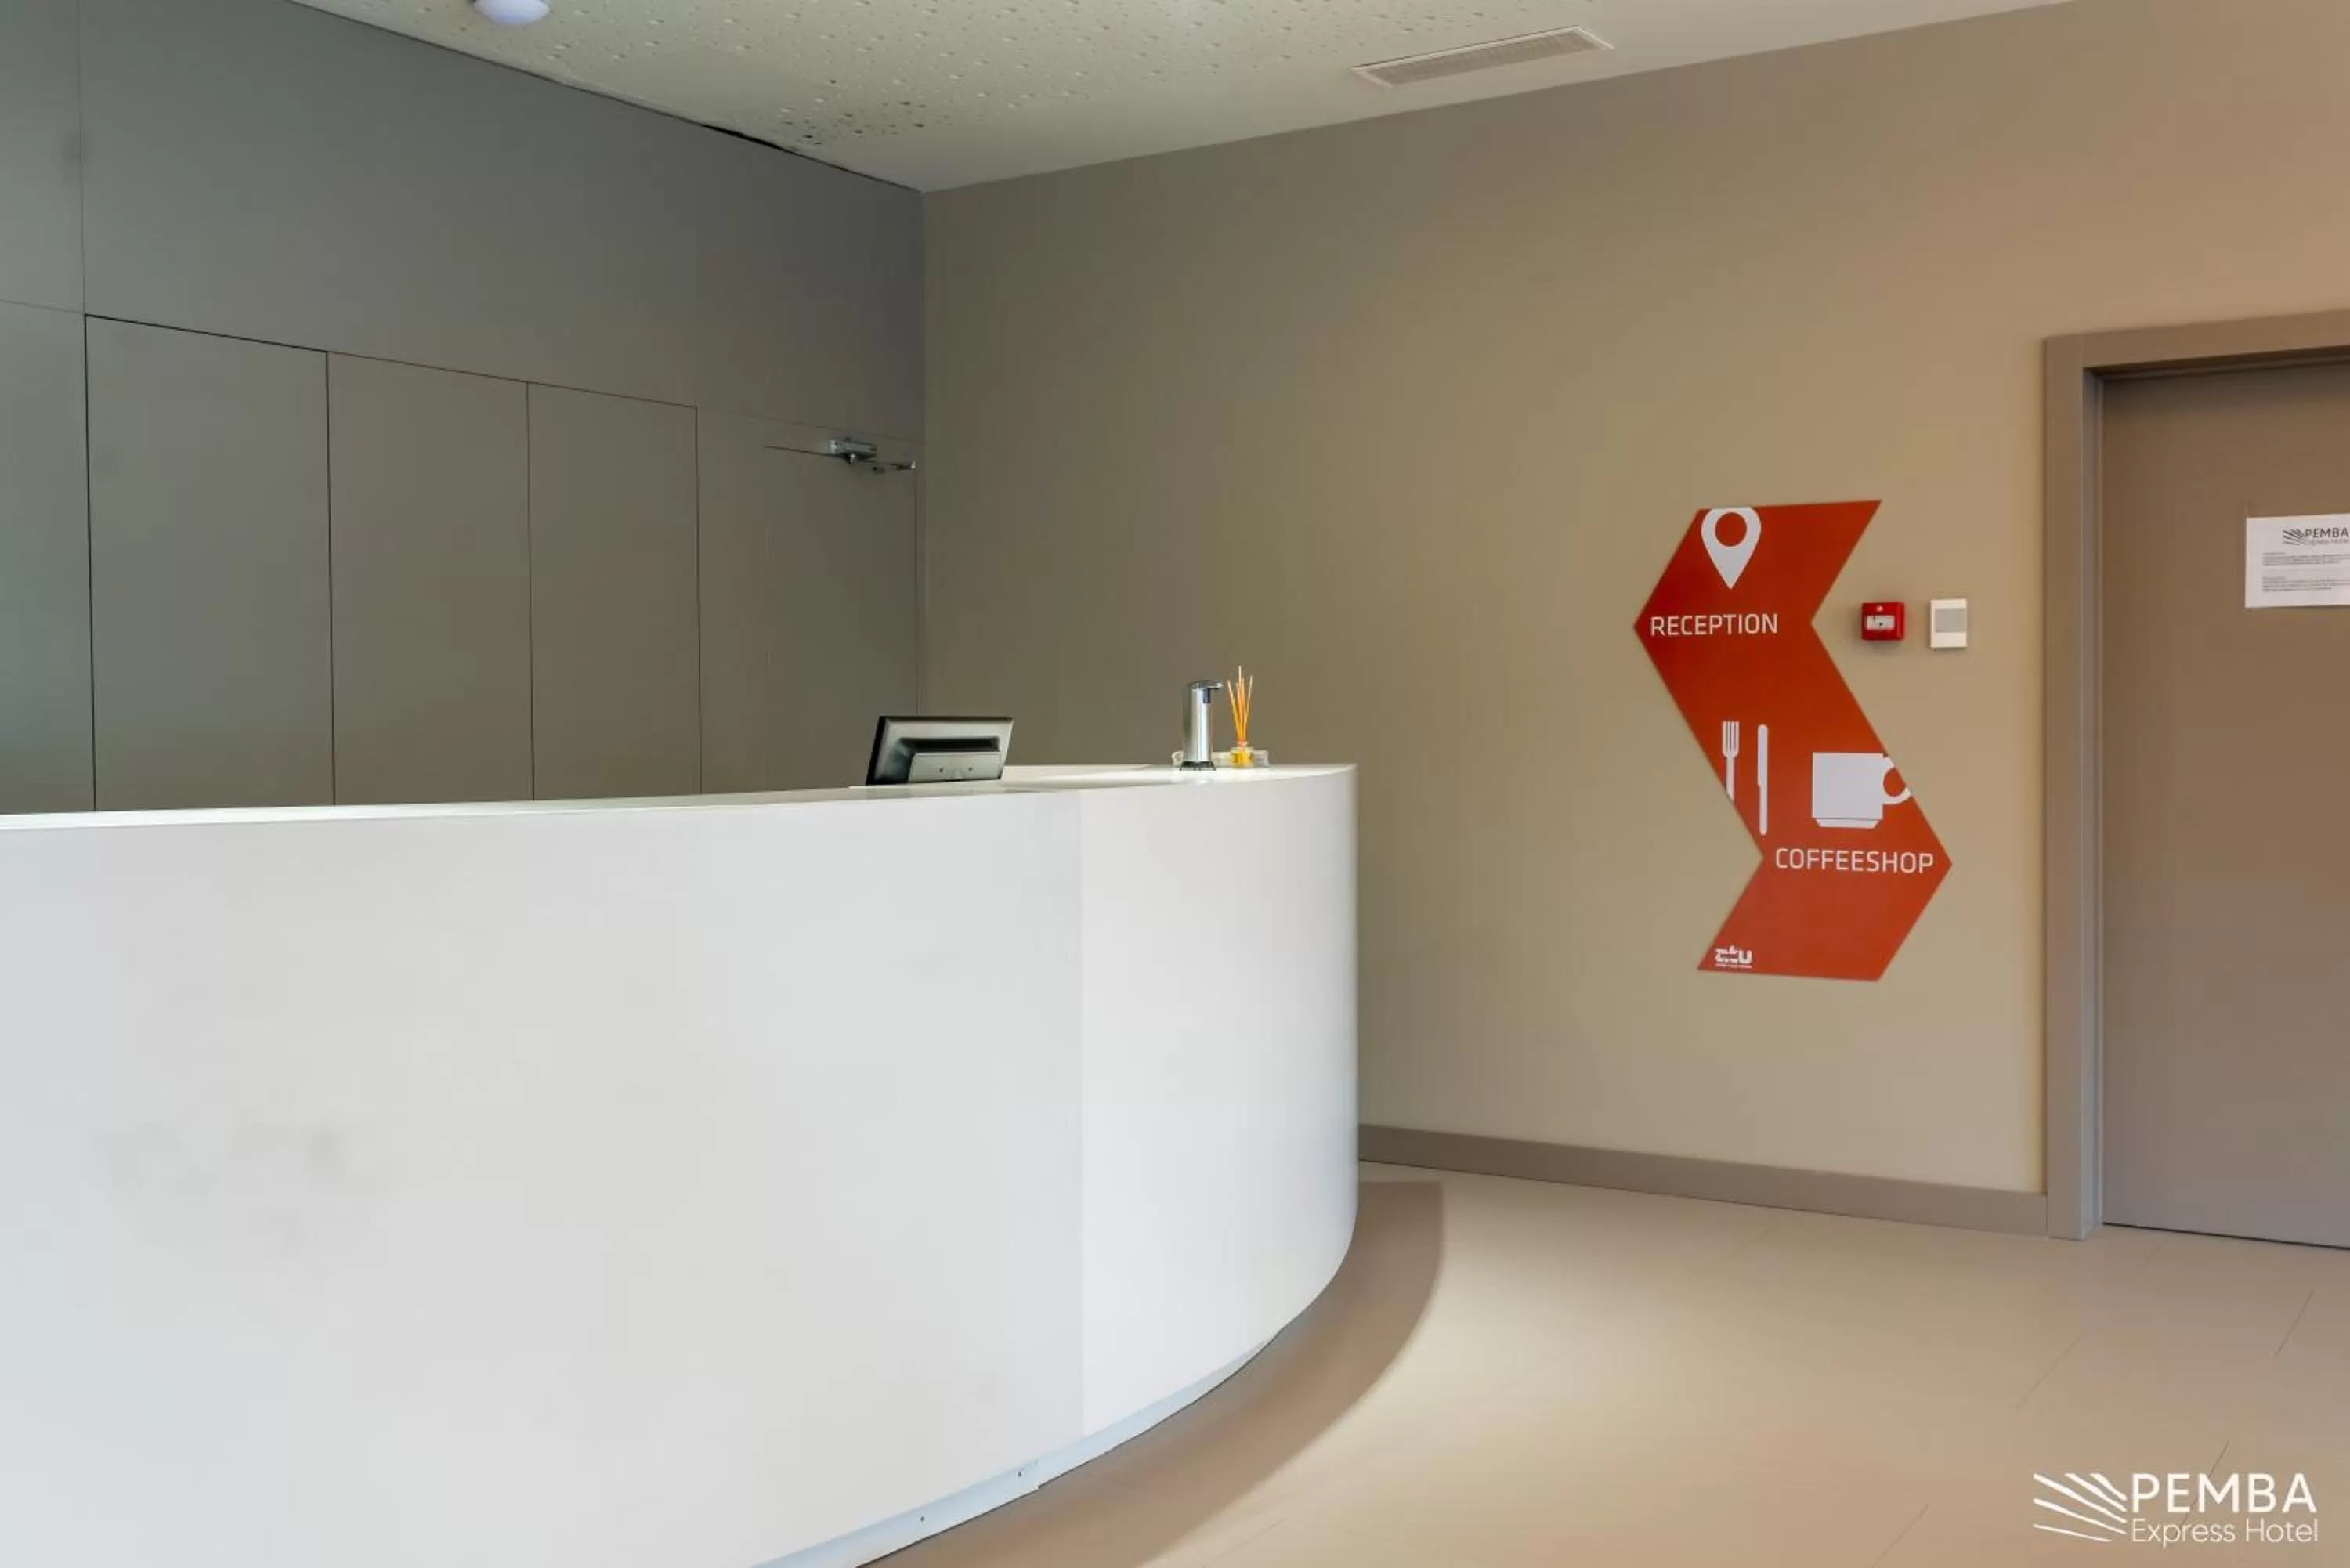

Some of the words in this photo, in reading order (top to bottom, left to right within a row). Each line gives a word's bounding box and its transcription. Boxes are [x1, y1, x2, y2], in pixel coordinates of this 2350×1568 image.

[2305, 527, 2349, 539] PEMBA
[1650, 613, 1778, 636] RECEPTION
[1775, 848, 1934, 873] COFFEESHOP
